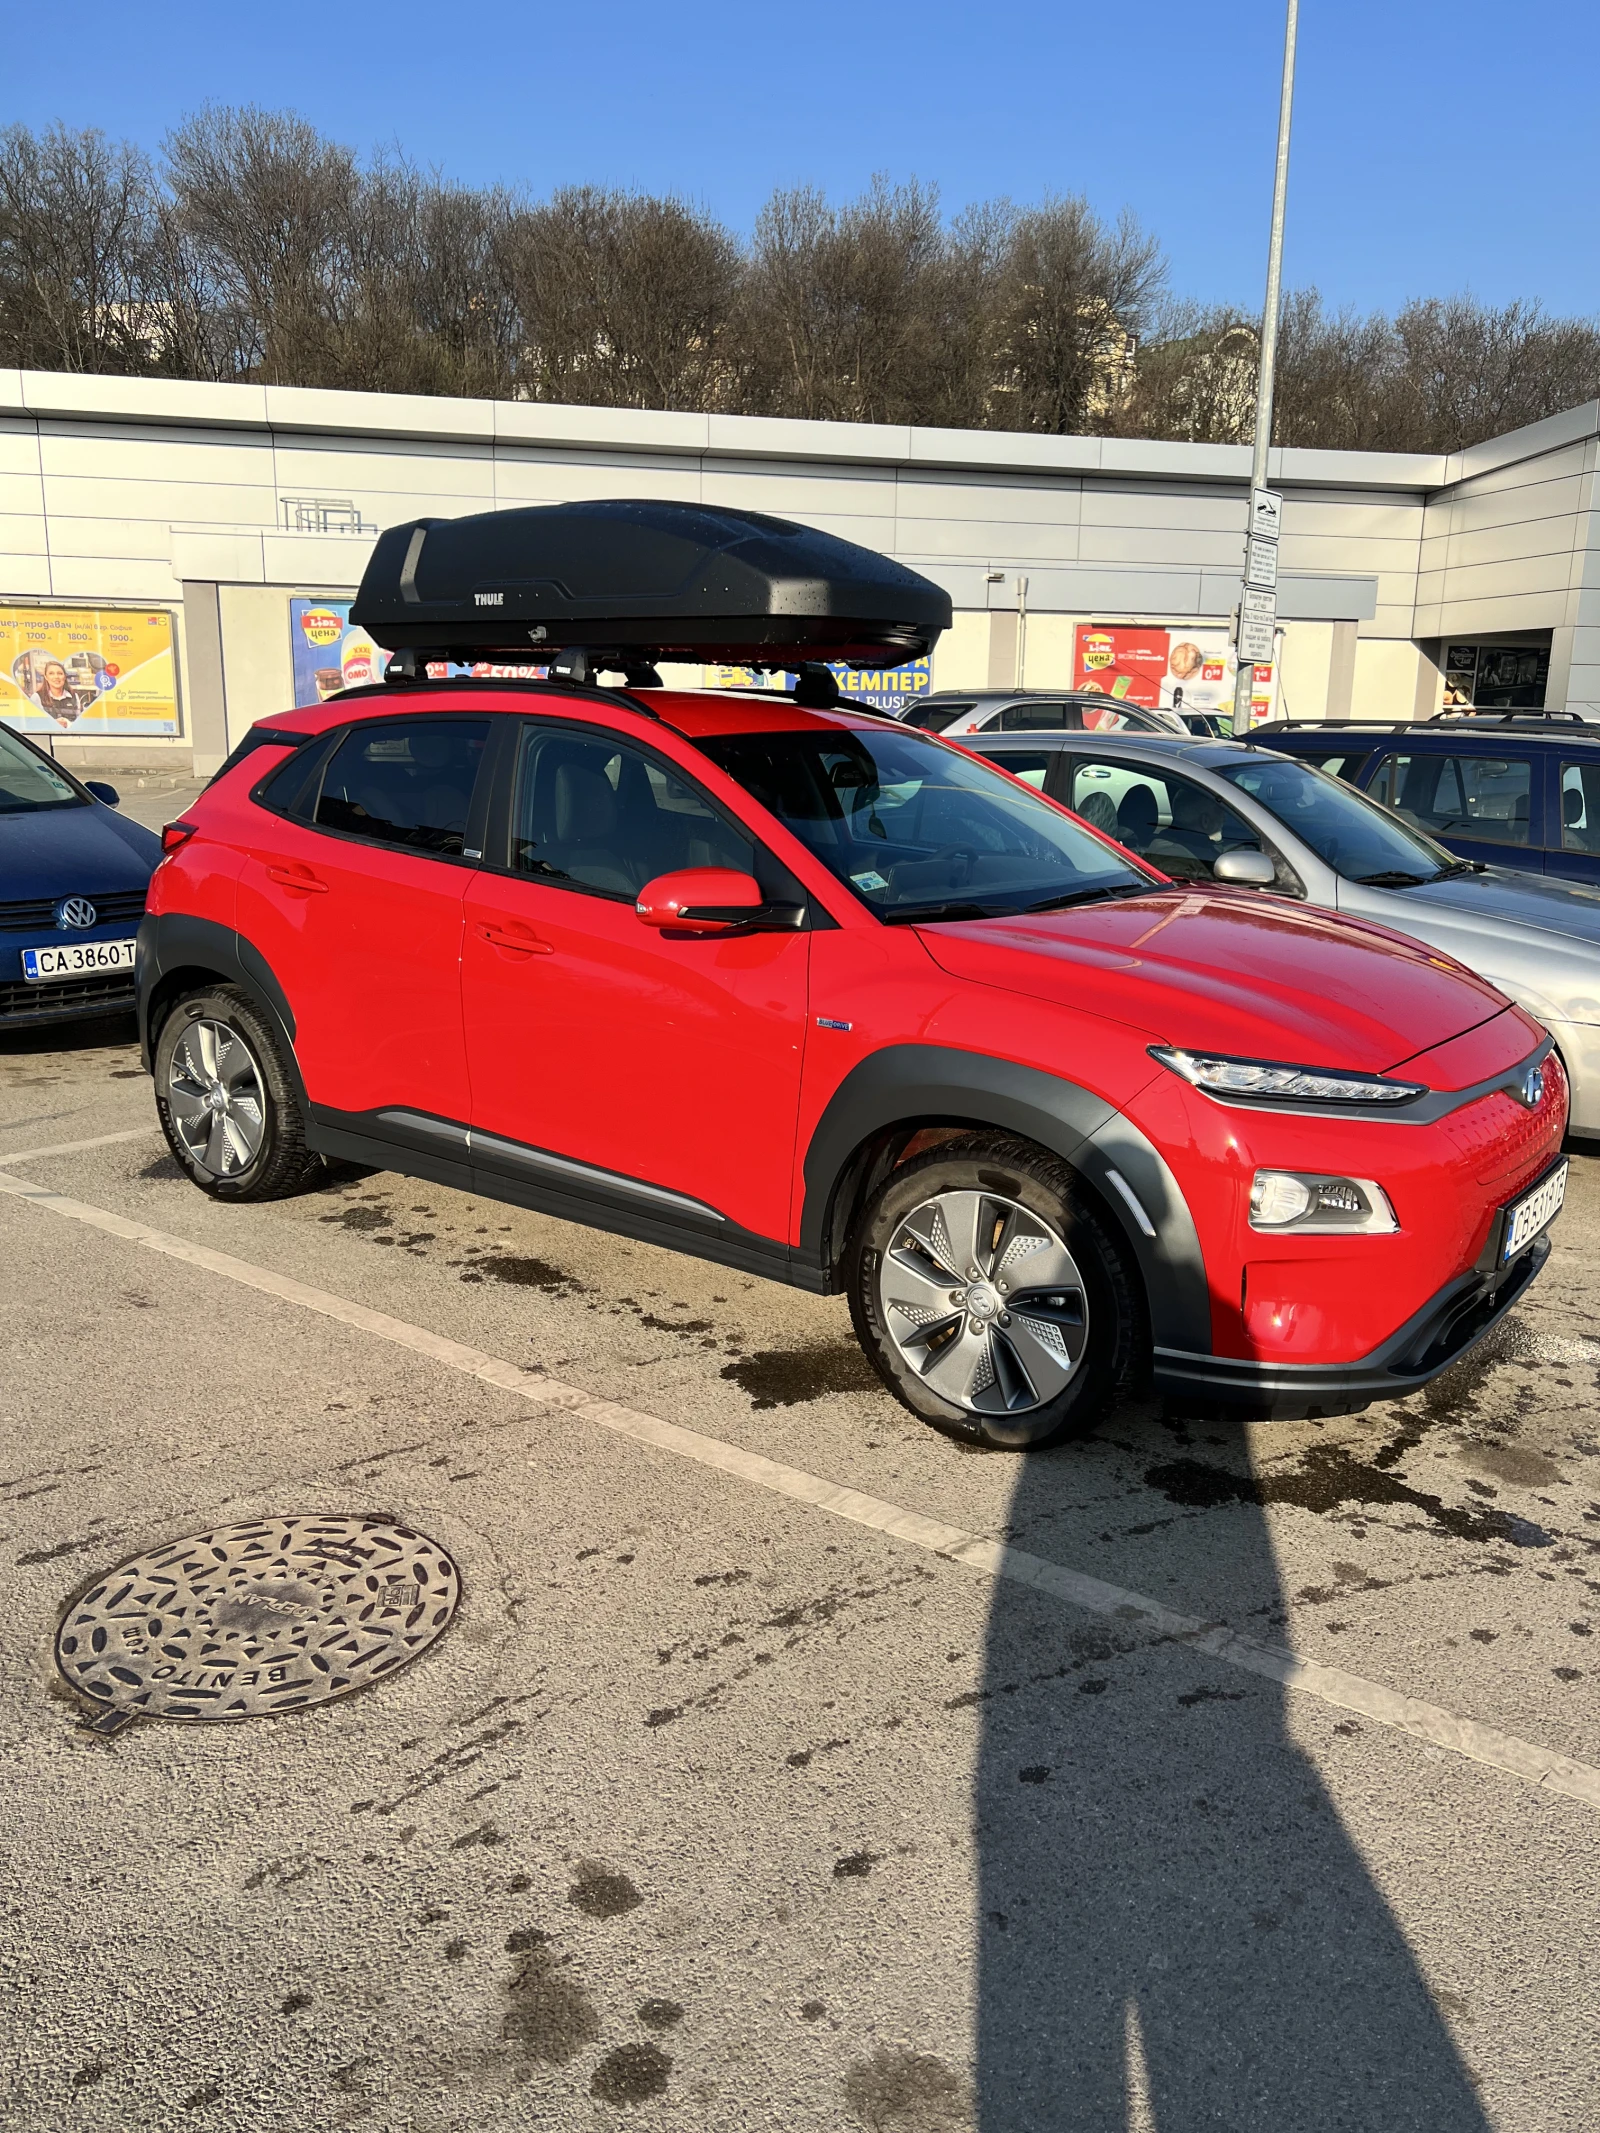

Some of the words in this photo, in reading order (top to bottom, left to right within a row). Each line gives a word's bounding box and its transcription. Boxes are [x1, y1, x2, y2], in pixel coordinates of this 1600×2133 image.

[474, 593, 504, 606] THULE
[26, 632, 46, 640] 1700
[67, 633, 88, 641] 1800
[109, 634, 129, 642] 1900
[310, 629, 336, 640] цена
[1088, 654, 1110, 664] цена
[347, 669, 368, 680] OMO
[831, 671, 929, 691] КЕМПЕР
[228, 1593, 314, 1618] DEPLAN
